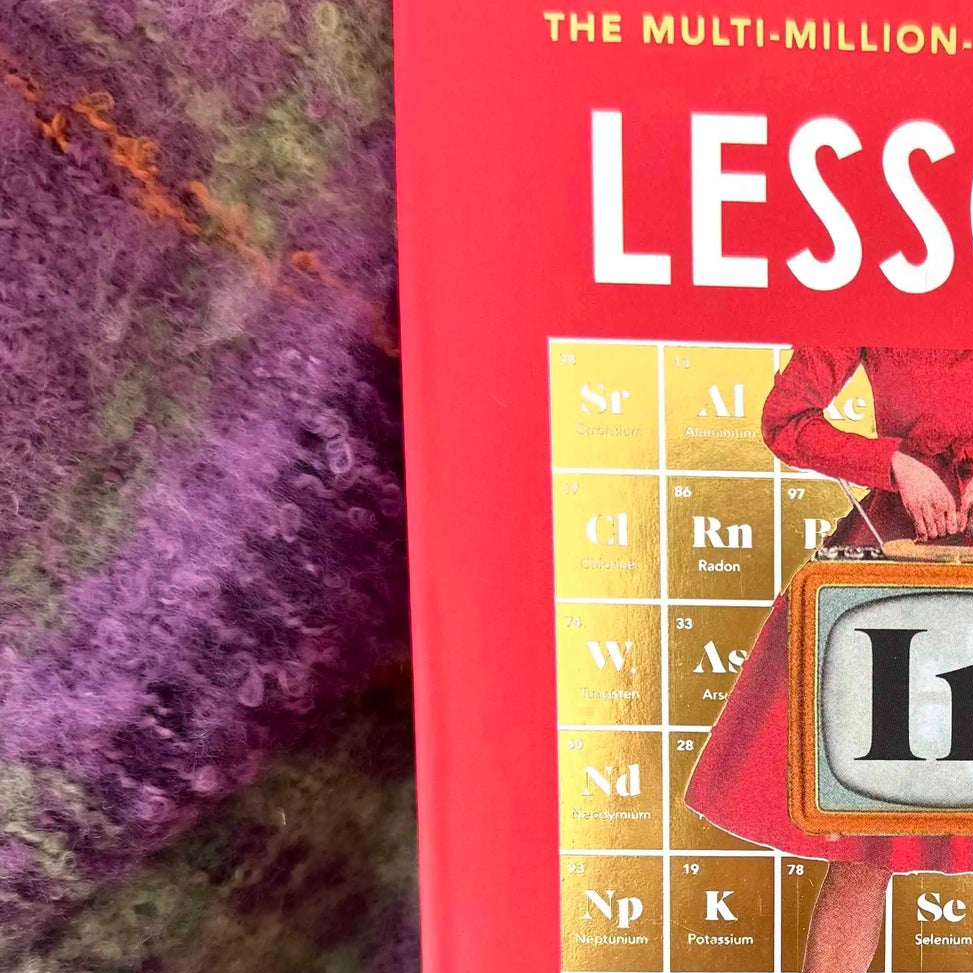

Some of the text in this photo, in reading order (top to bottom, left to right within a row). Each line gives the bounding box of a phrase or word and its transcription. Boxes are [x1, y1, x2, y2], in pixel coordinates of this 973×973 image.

[543, 11, 623, 43] THE
[580, 383, 630, 415] Sr
[697, 383, 746, 417] Al
[684, 427, 756, 439] Aluminium
[674, 485, 692, 498] 86
[787, 488, 806, 500] 97
[586, 511, 630, 547] Cl
[692, 515, 753, 549] Rn
[698, 559, 741, 572] Radon
[676, 617, 693, 630] 33
[692, 640, 749, 674] As
[579, 688, 640, 702] Tungsten
[677, 739, 694, 751] 28
[581, 763, 642, 797] Nd
[572, 808, 652, 823] Neodymium
[567, 862, 585, 874] 93
[683, 863, 700, 875] 19
[787, 864, 804, 876] 78
[583, 889, 643, 929] Np
[705, 890, 738, 921] K
[916, 892, 967, 923] Se
[575, 933, 648, 946] Neptunium
[688, 933, 754, 946] Potassium
[915, 933, 973, 946] Selenium
